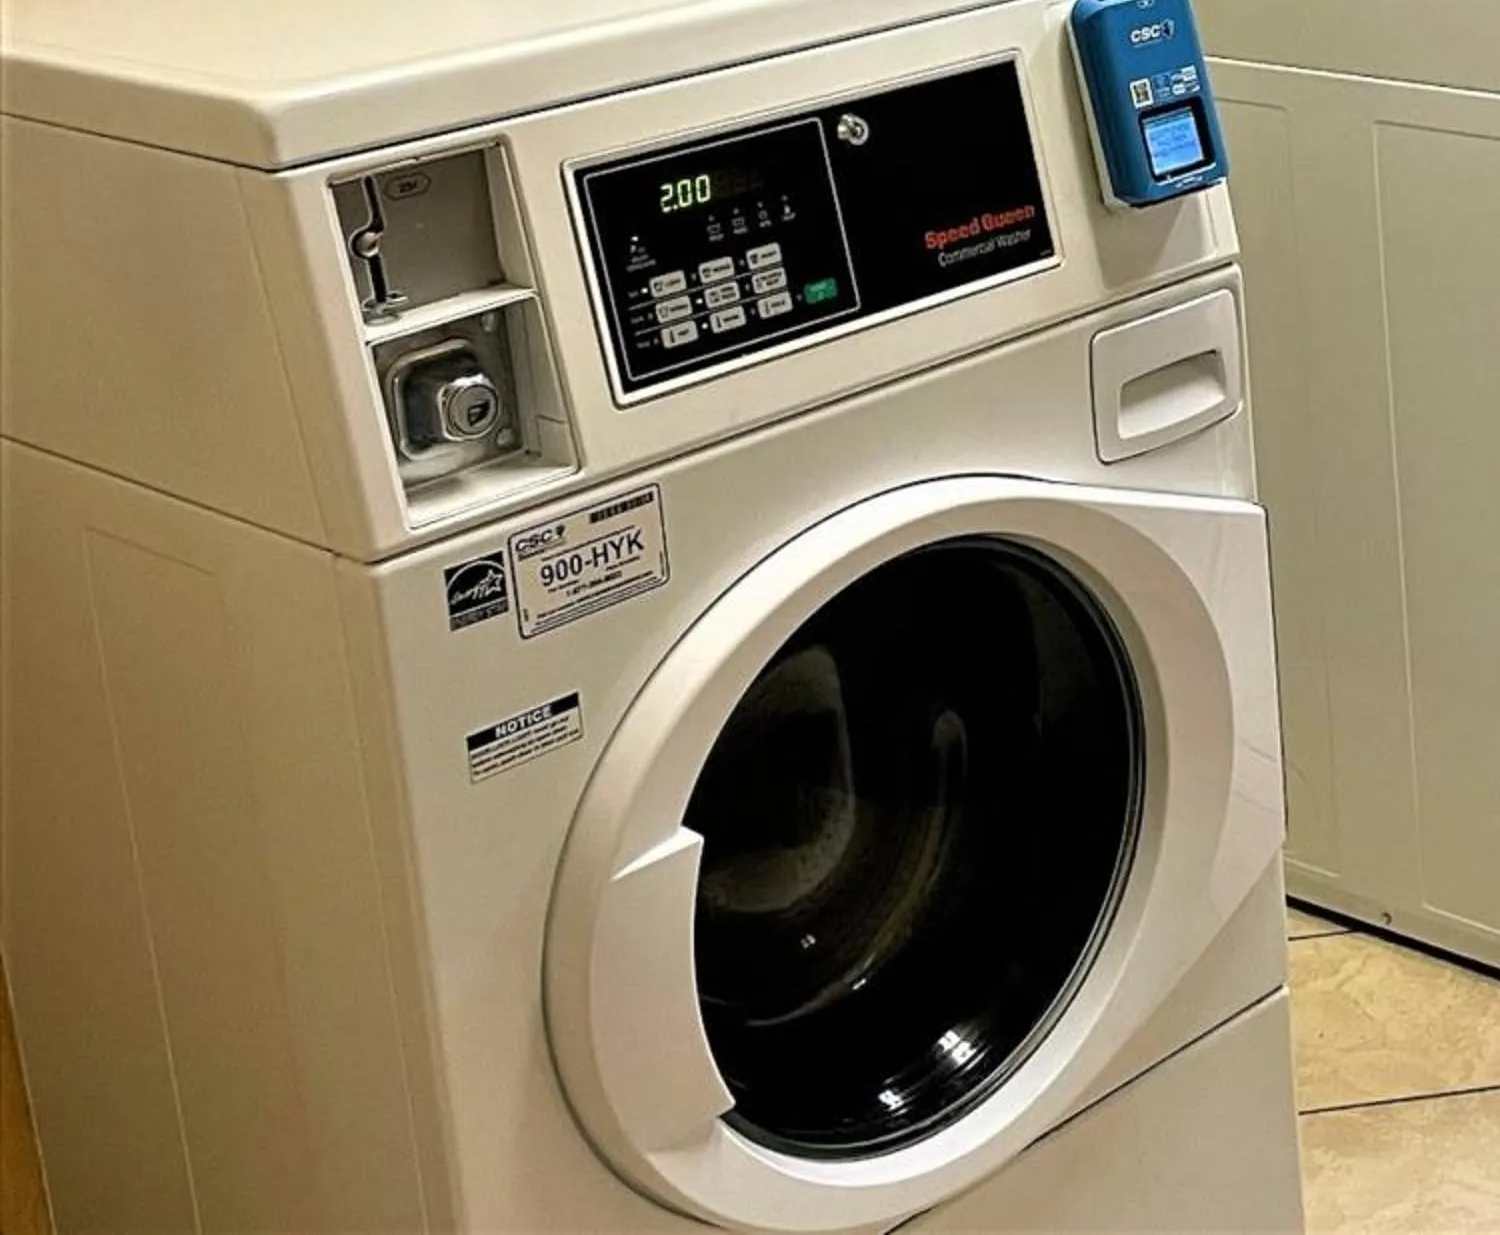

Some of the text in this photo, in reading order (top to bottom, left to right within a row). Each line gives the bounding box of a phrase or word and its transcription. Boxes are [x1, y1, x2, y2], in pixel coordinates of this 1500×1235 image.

[1130, 24, 1160, 43] CSC
[660, 174, 711, 213] 2.00
[925, 205, 1035, 249] Speed Queen
[515, 529, 553, 553] CSC
[540, 529, 645, 587] 900-HYK
[494, 705, 553, 738] NOTICE
